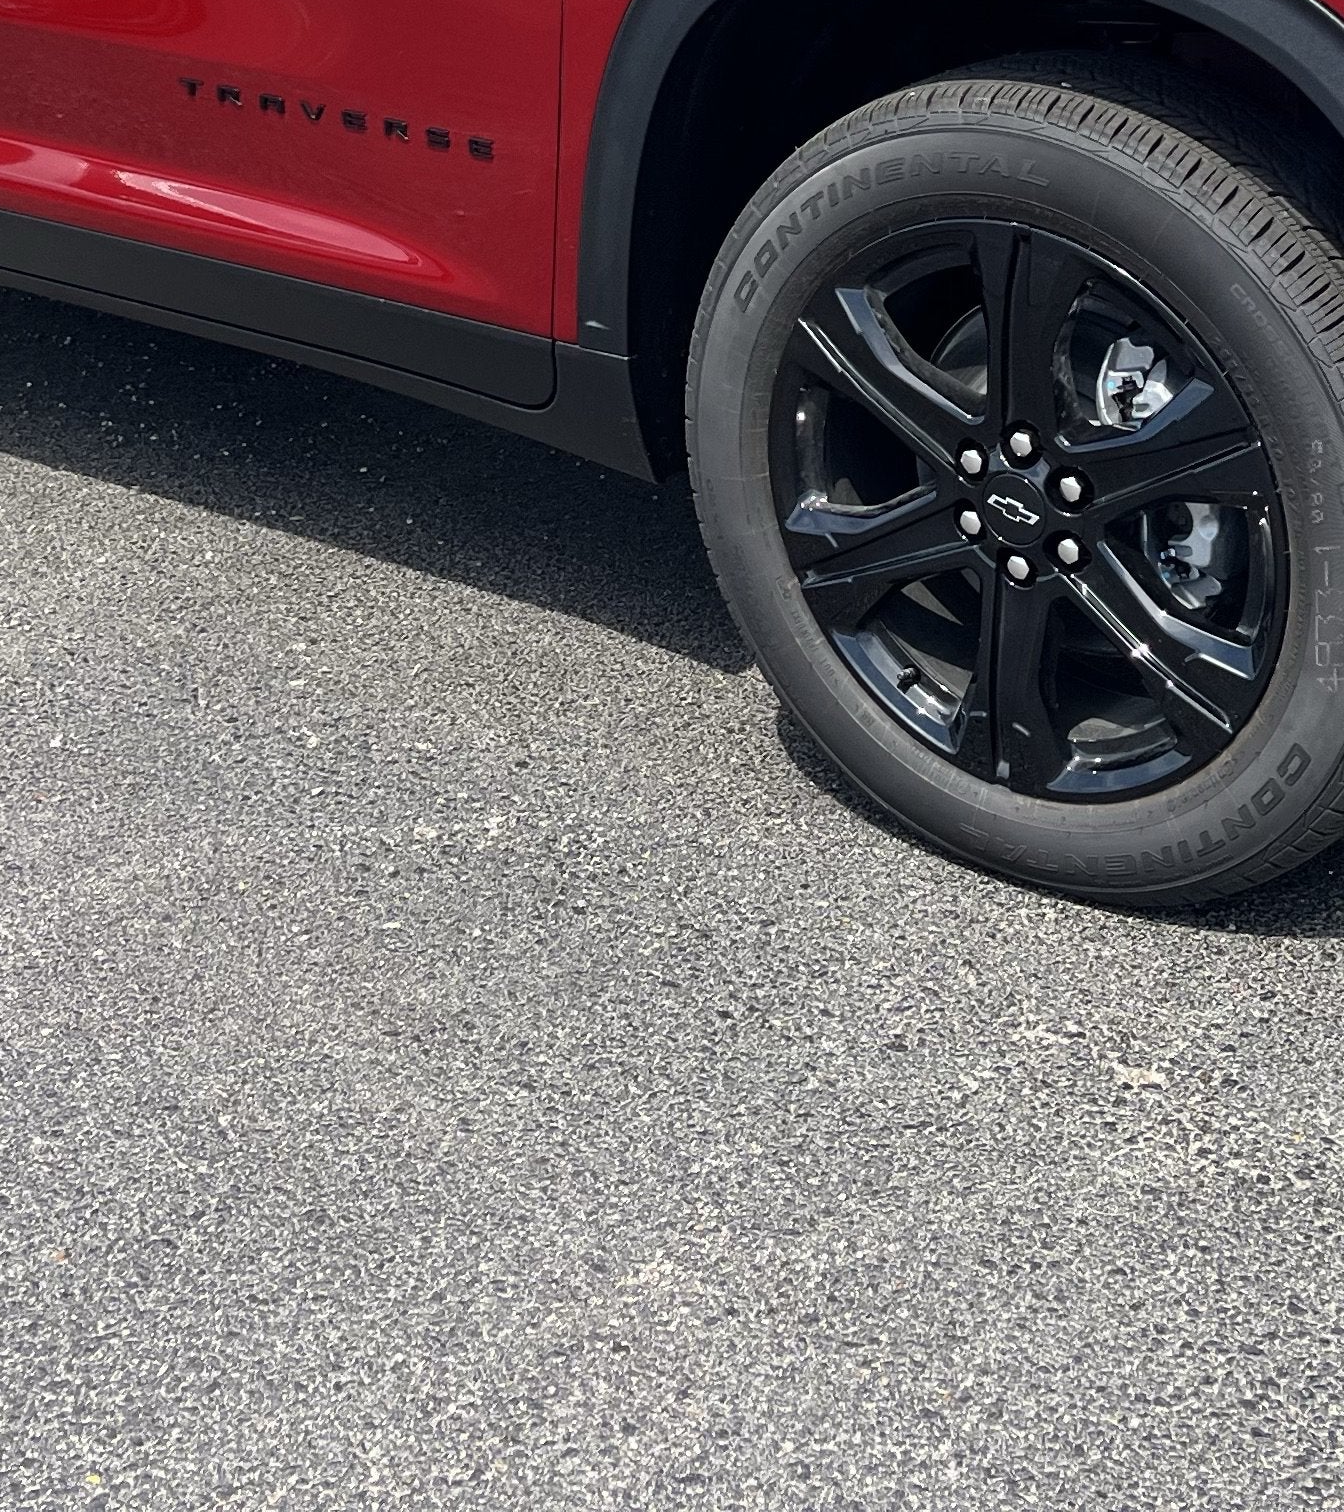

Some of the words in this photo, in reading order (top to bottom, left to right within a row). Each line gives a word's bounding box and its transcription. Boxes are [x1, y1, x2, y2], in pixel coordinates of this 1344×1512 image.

[179, 76, 495, 162] TRAVERSE
[733, 151, 1051, 314] CONTINENTAL
[959, 741, 1312, 877] CONTINENTAL
